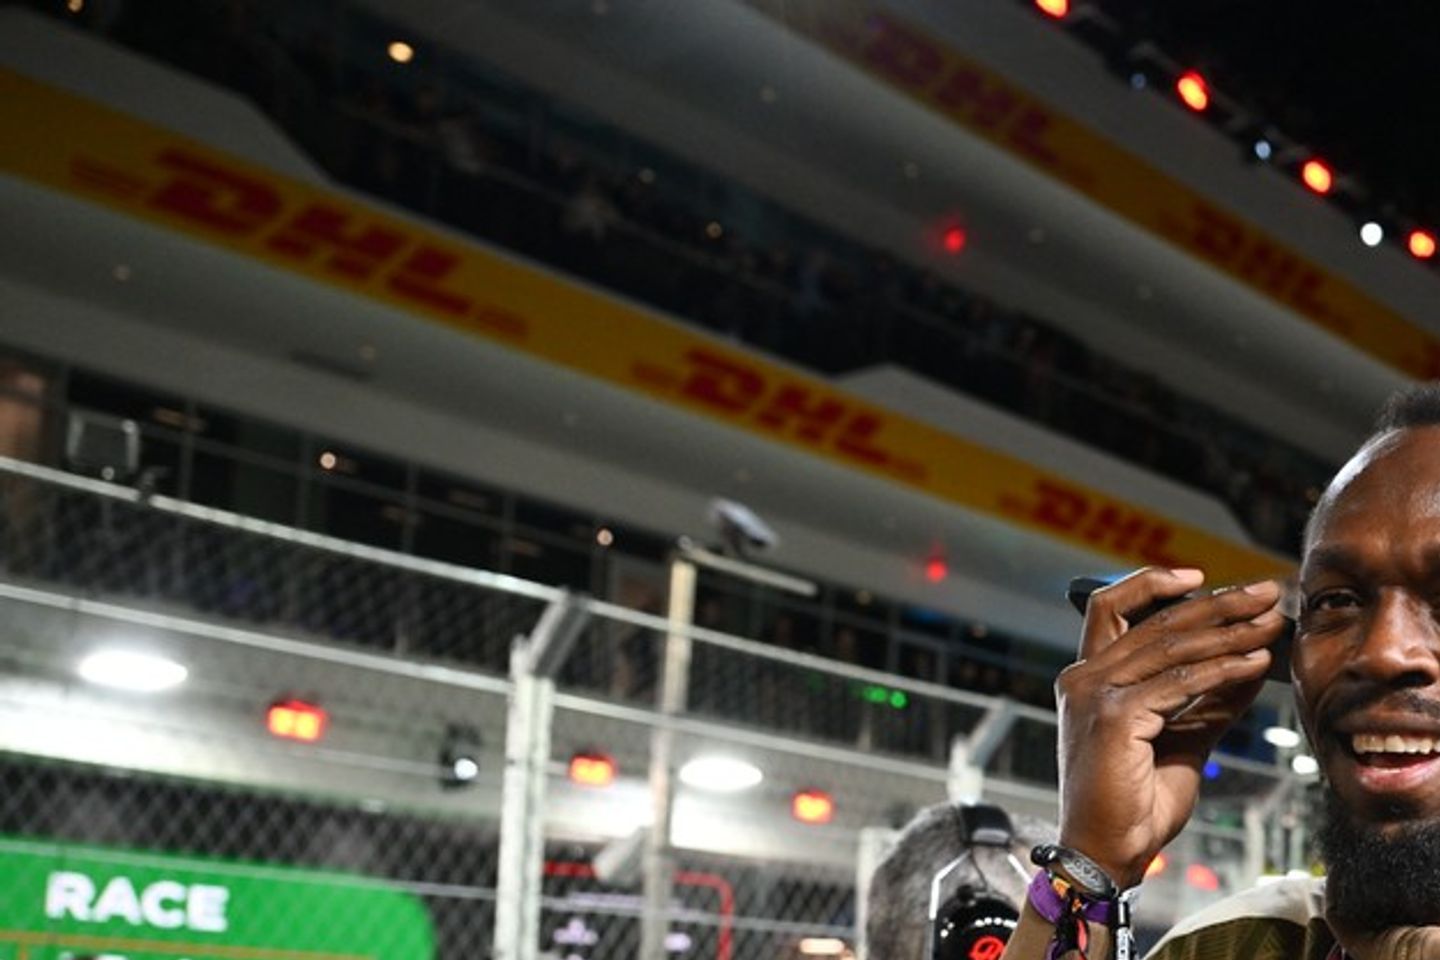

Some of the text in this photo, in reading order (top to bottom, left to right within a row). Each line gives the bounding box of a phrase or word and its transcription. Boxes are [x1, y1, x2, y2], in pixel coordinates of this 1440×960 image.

[143, 147, 474, 318] DHL
[680, 346, 892, 468] DHL
[1030, 478, 1198, 570] DHL
[45, 870, 231, 933] RACE
